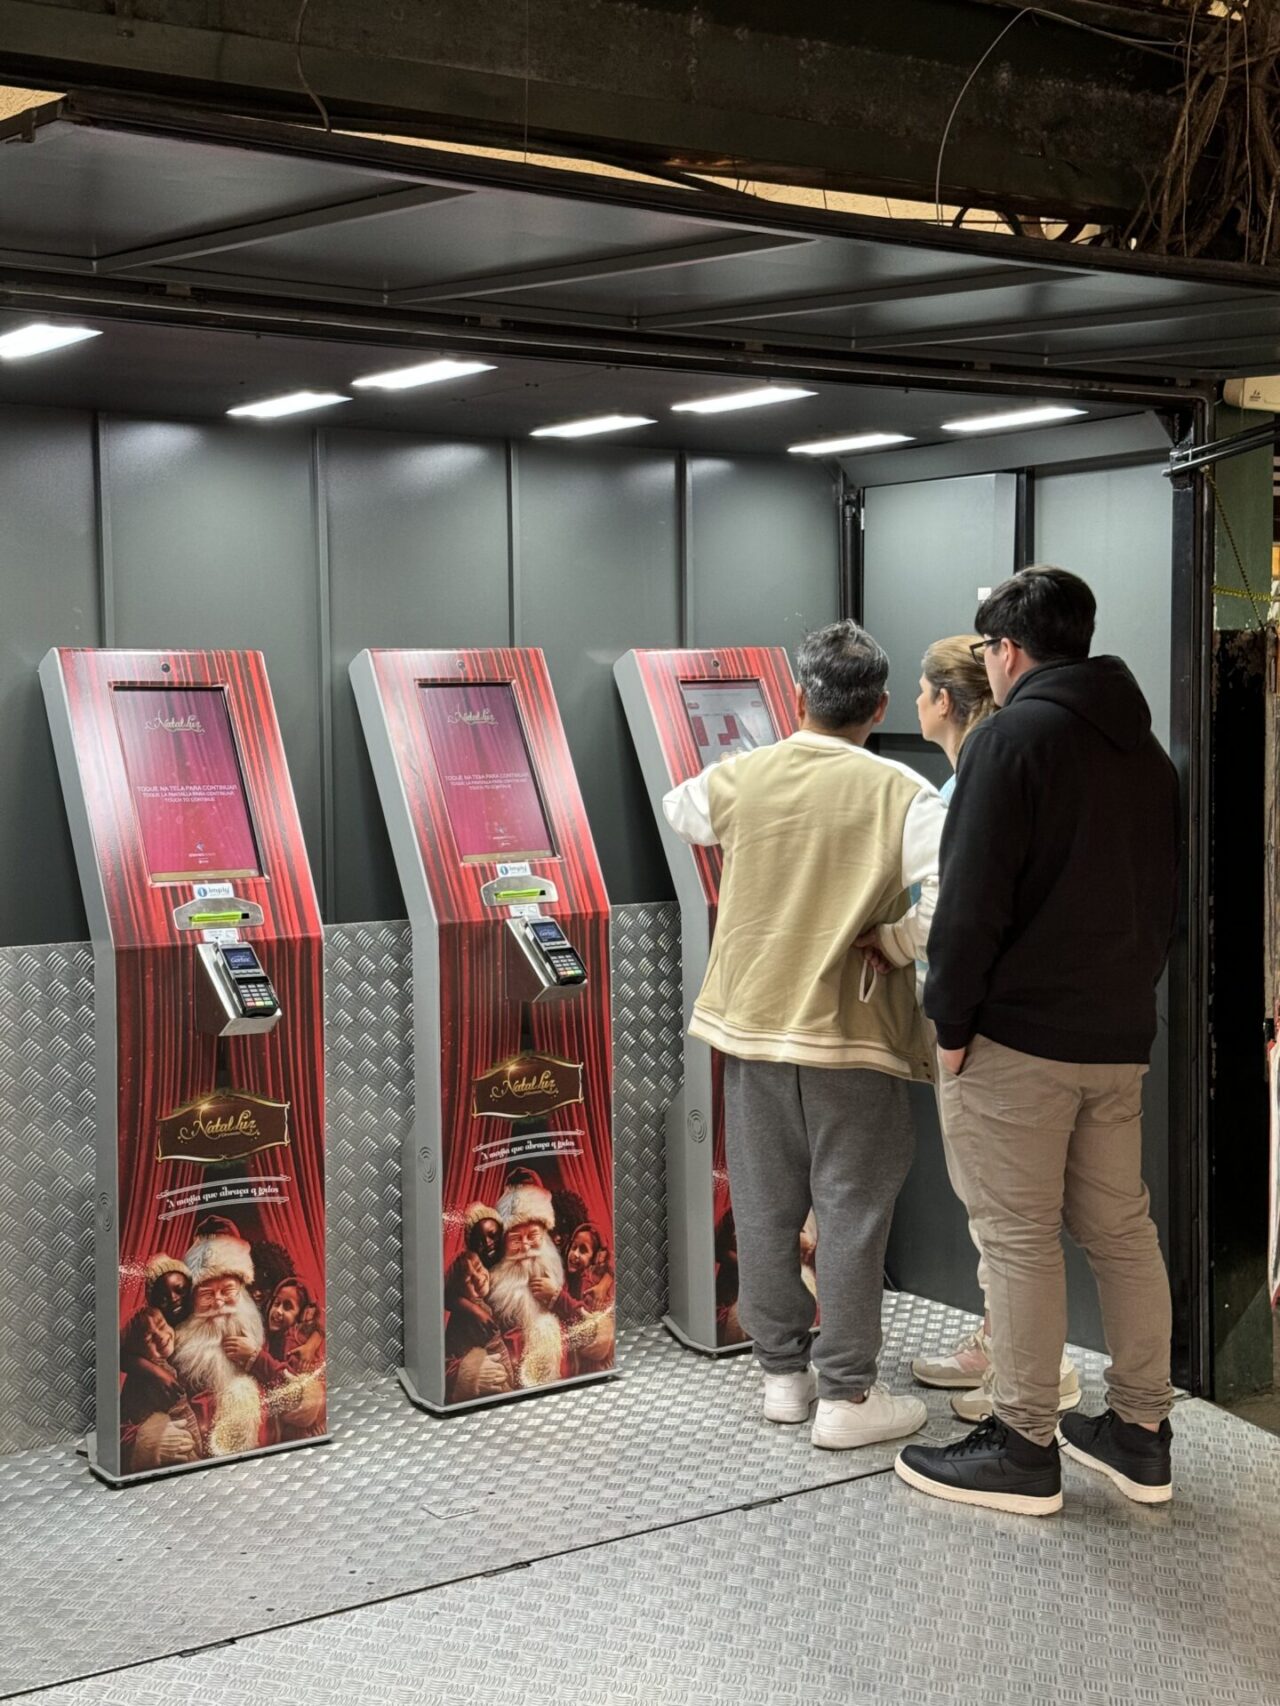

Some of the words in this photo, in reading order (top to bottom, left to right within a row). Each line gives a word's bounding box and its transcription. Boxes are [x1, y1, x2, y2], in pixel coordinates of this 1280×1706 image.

[491, 1070, 535, 1099] Natal
[535, 1070, 559, 1095] Luz
[179, 1110, 234, 1140] Natal
[234, 1109, 260, 1137] Luz
[511, 1145, 525, 1154] que
[525, 1139, 550, 1150] abraça
[176, 1194, 201, 1206] magia
[202, 1192, 218, 1201] que
[219, 1186, 249, 1197] abraça
[258, 1185, 279, 1196] todos
